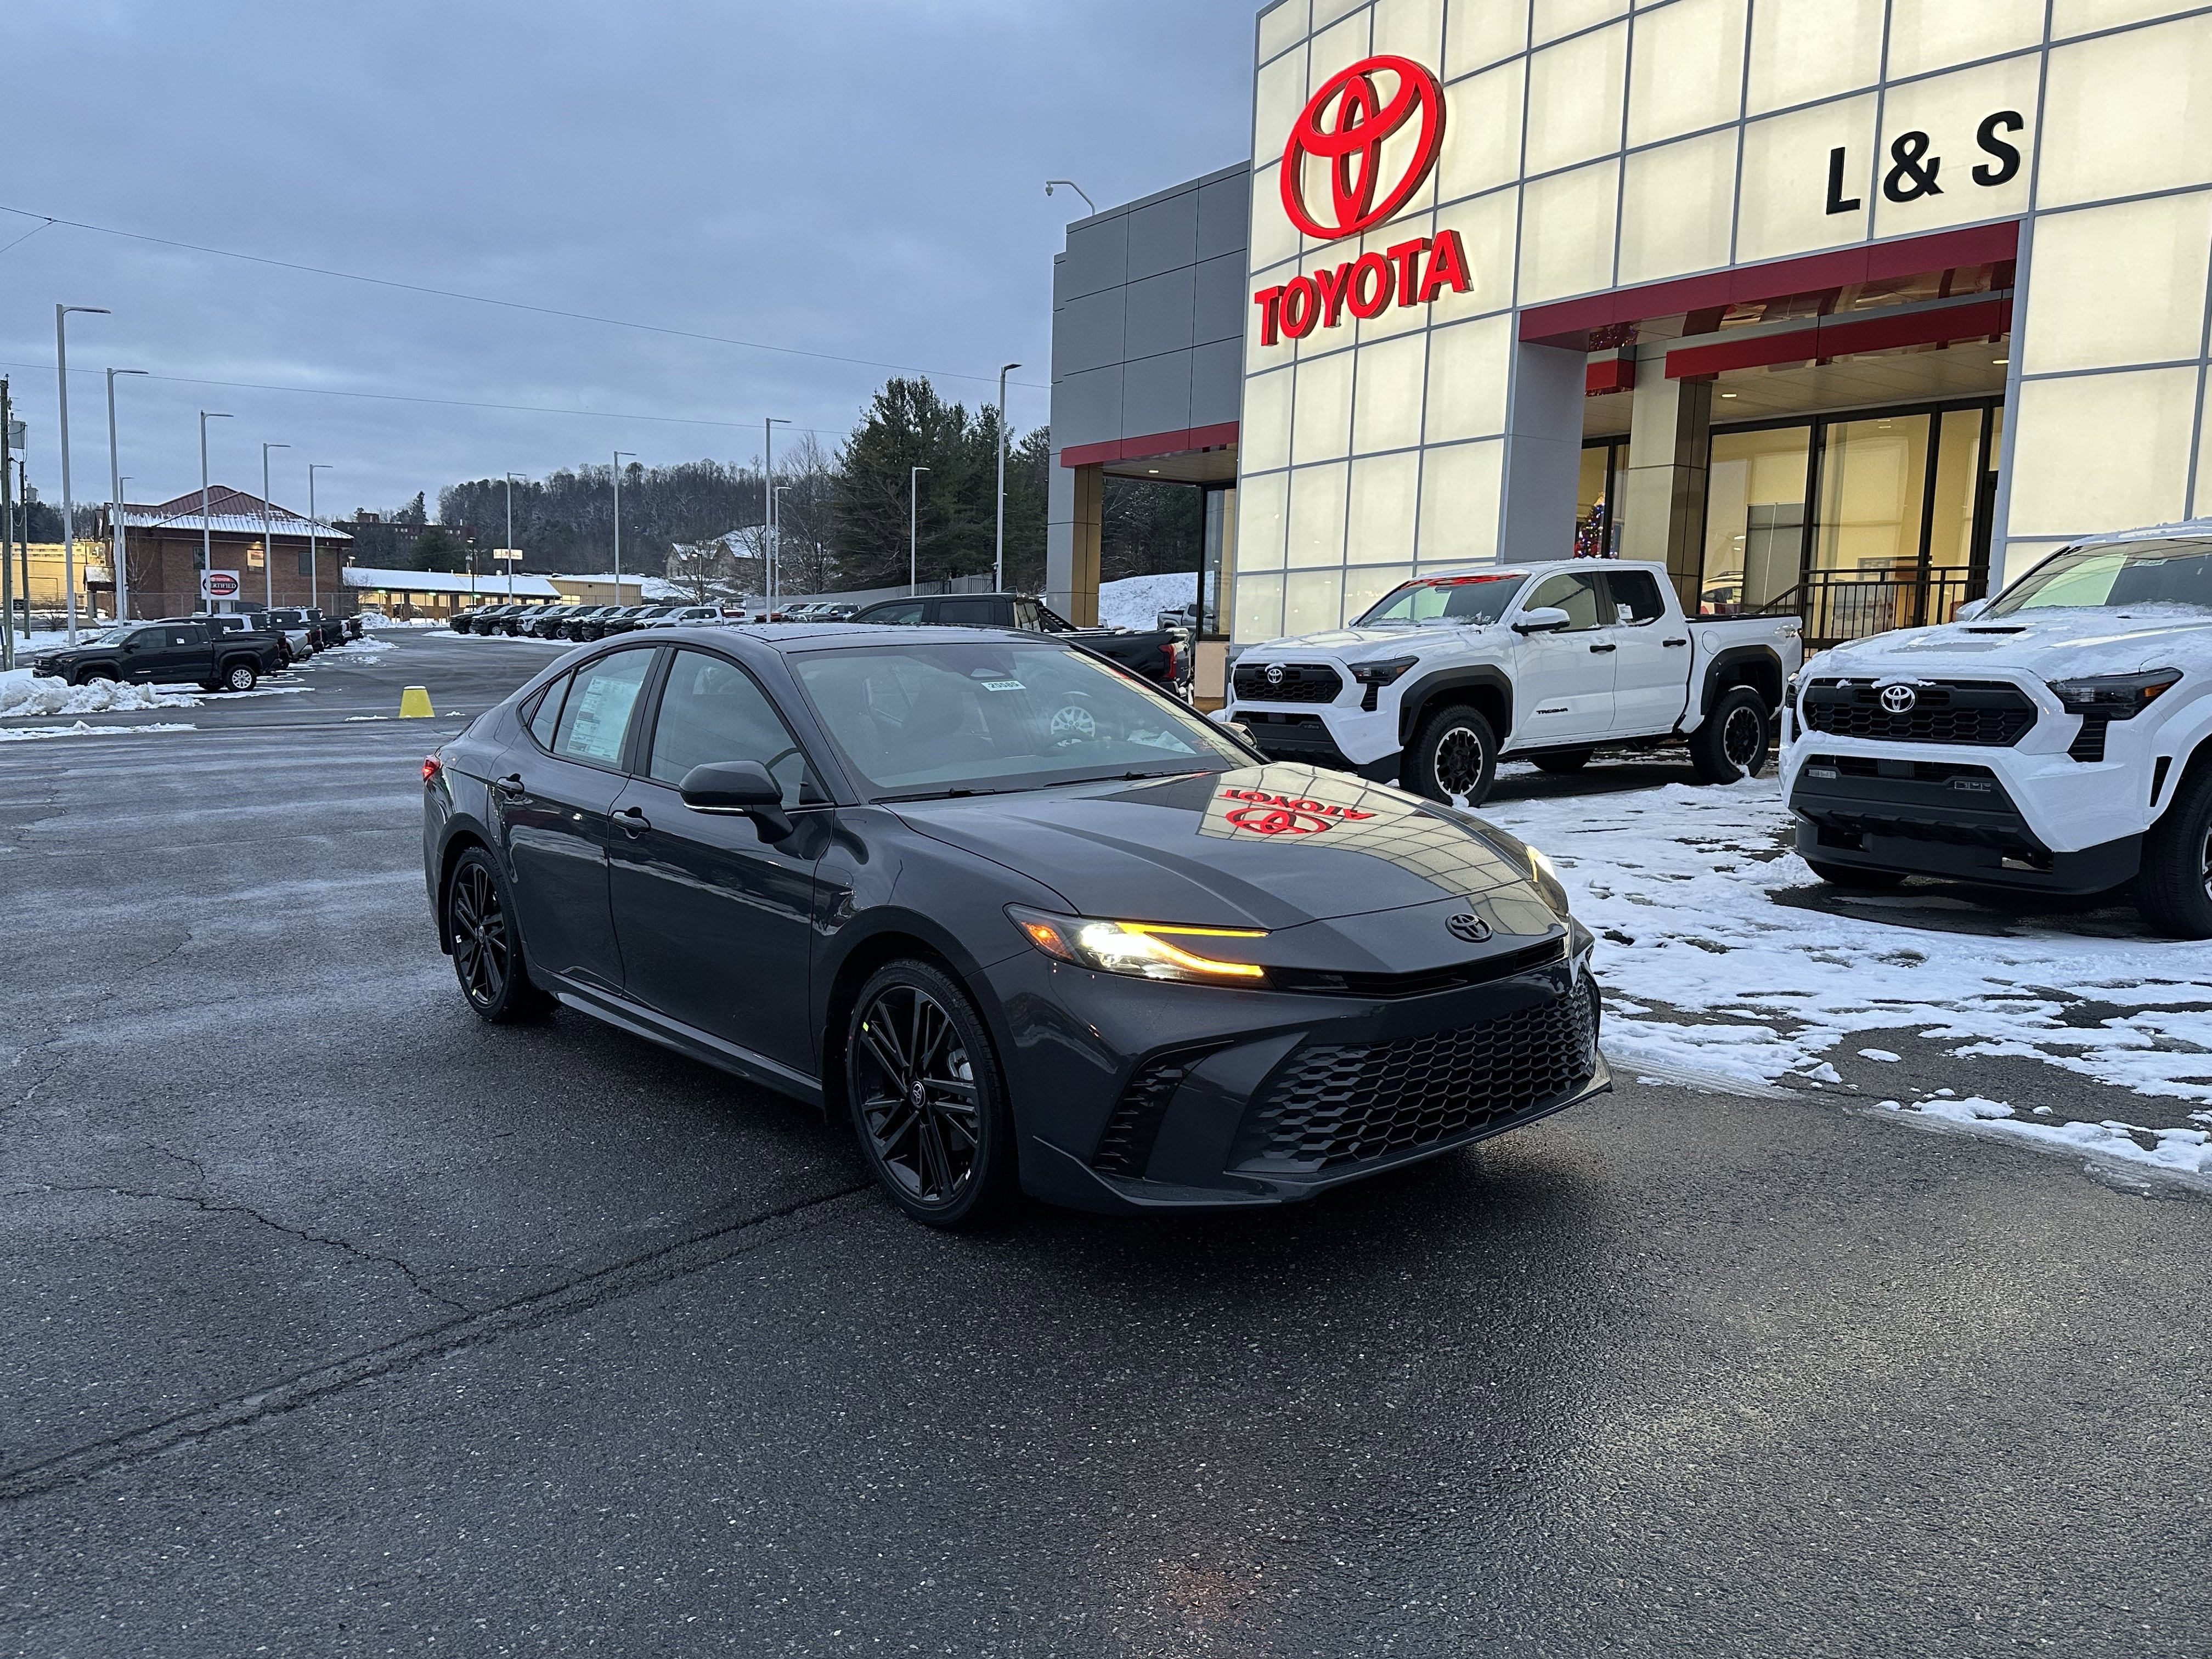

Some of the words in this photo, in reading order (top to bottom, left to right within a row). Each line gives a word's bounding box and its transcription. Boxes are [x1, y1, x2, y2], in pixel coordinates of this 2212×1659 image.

[1826, 147, 1860, 215] L
[1883, 131, 1944, 202] &
[1972, 111, 2024, 187] S
[1255, 229, 1474, 346] TOYOTA
